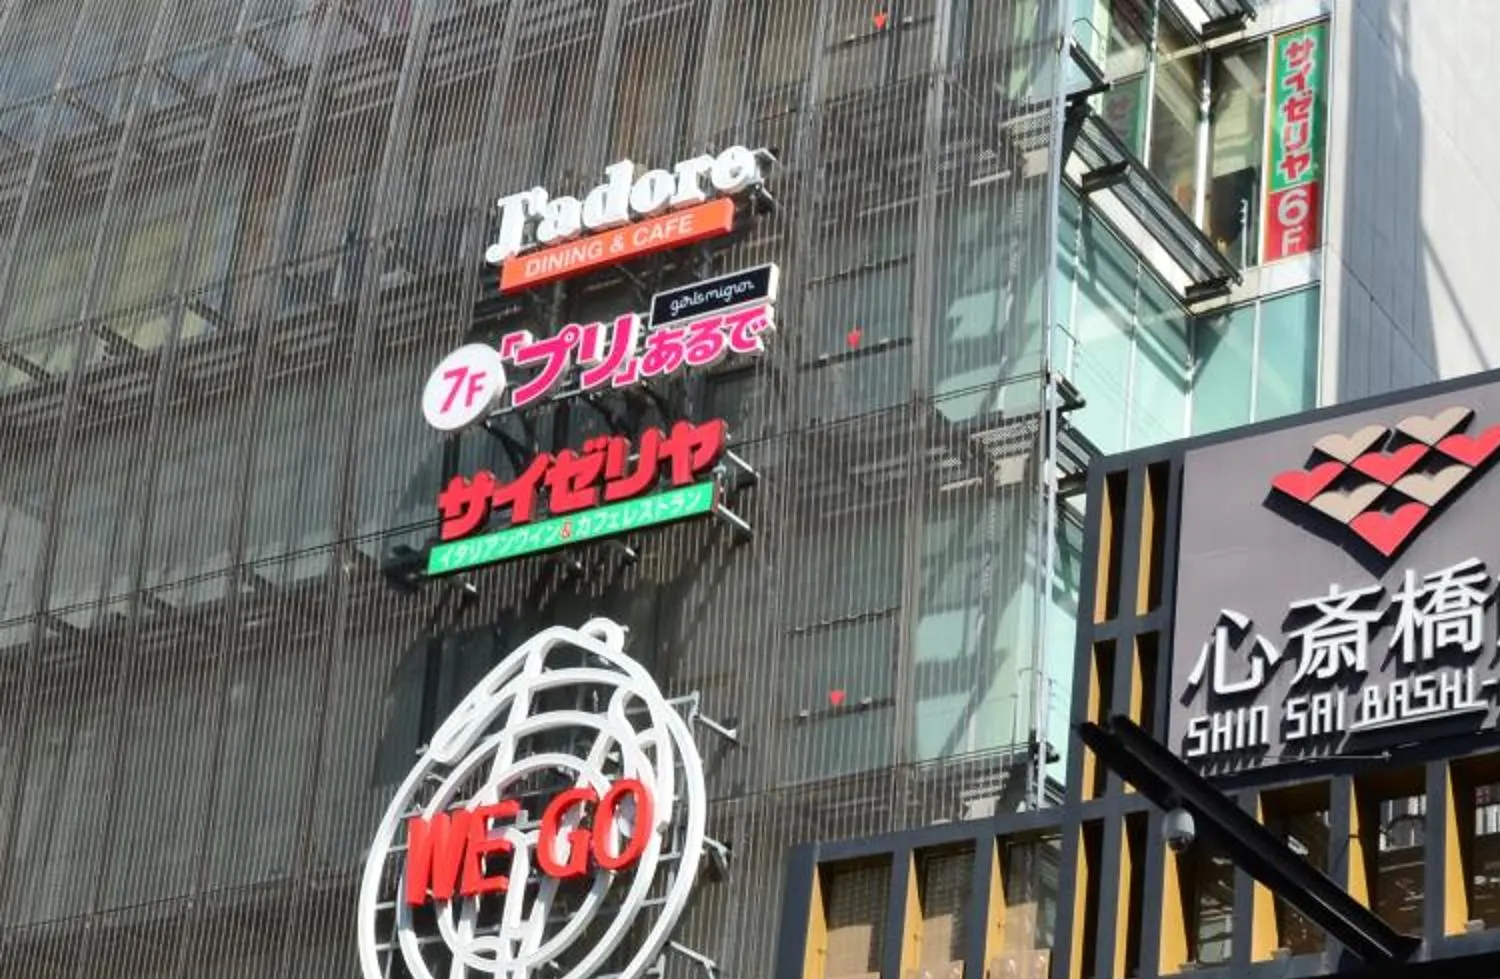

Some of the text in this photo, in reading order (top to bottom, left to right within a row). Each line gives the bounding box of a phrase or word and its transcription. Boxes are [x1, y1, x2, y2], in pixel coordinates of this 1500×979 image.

[1280, 36, 1316, 182] サイゼリヤ
[524, 213, 695, 278] DINING & CAFE
[438, 367, 487, 415] 7F
[438, 419, 729, 540] サイゼリヤ
[1187, 704, 1268, 757] SHIN
[1285, 697, 1346, 741] SAI
